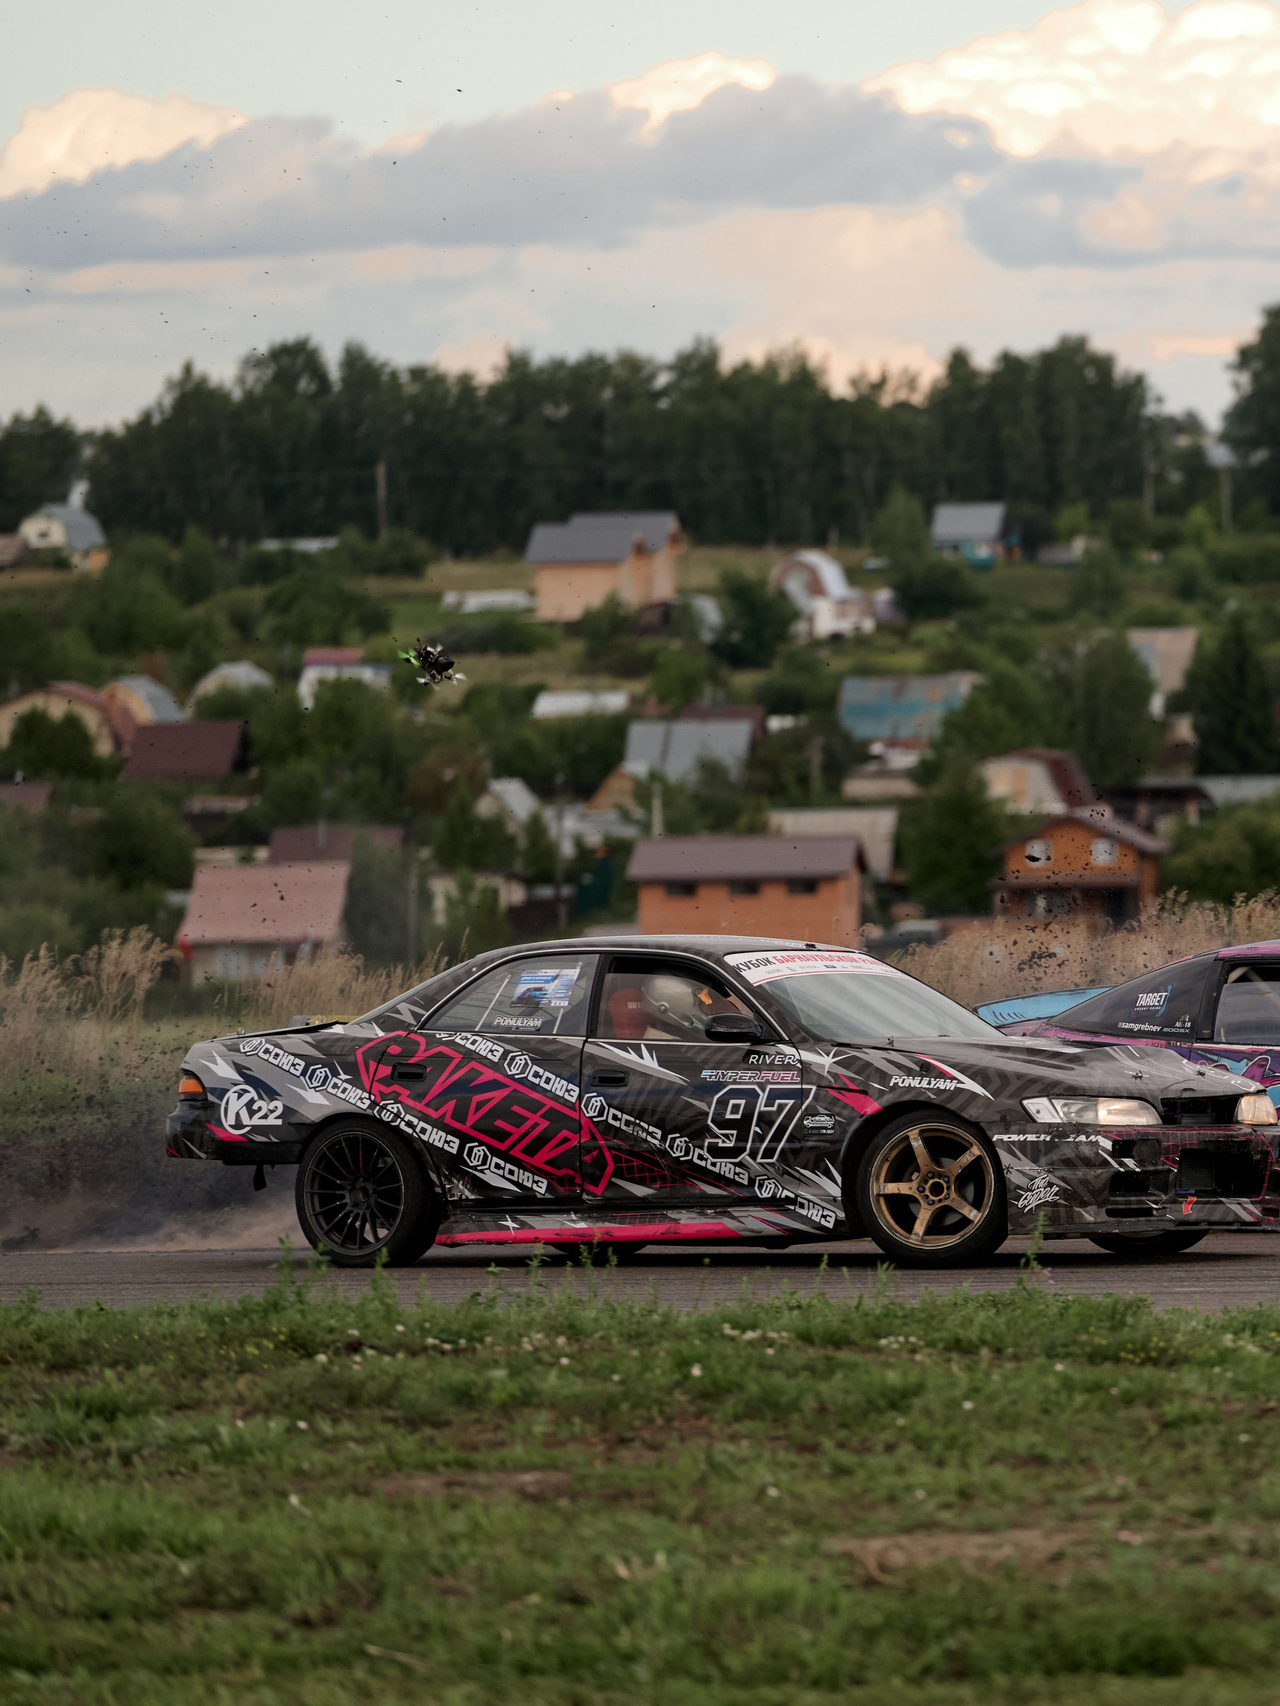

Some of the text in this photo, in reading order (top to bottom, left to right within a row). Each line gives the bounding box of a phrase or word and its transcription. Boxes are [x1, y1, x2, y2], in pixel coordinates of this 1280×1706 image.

[732, 956, 777, 973] КУБОК
[772, 953, 859, 966] БАРНАУЛЬСКОЙ
[1135, 992, 1168, 1007] TARGET
[493, 1015, 543, 1027] PONULYAM
[1117, 1021, 1162, 1032] @samgrebnev
[454, 1032, 505, 1062] СОЮЗ
[527, 1065, 580, 1103] СОЮЗ
[748, 1054, 799, 1065] RIVER
[889, 1075, 958, 1091] PONULYAM
[221, 1086, 284, 1132] K22
[257, 1043, 548, 1195] СОЮЗ СОЮЗ СОЮЗ СОЮЗ
[704, 1085, 817, 1162] 97
[992, 1134, 1101, 1142] POWER EAM
